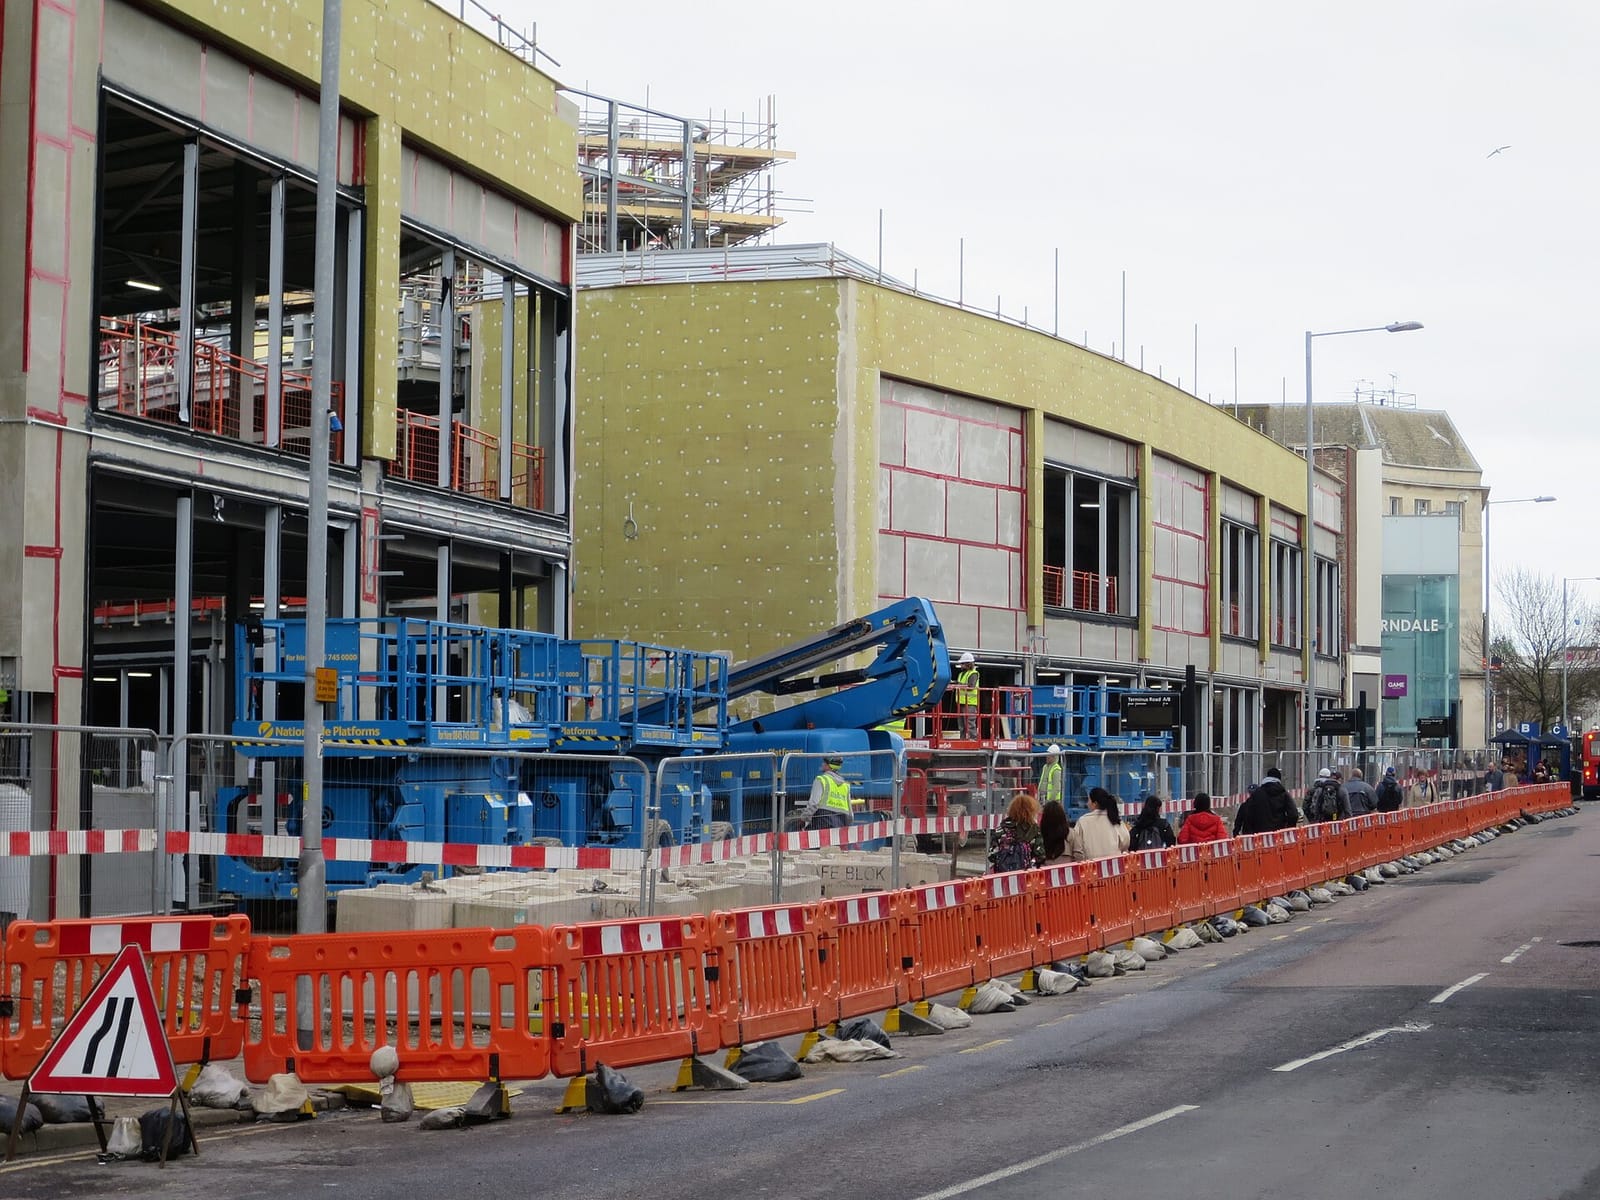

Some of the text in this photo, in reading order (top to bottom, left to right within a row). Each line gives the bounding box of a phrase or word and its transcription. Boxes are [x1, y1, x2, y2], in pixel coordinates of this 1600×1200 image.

[296, 653, 306, 661] hir
[340, 653, 358, 661] 0000
[275, 726, 380, 737] Natioe Platforms
[1521, 723, 1530, 733] B
[1552, 726, 1561, 735] C
[845, 865, 886, 881] BLOK
